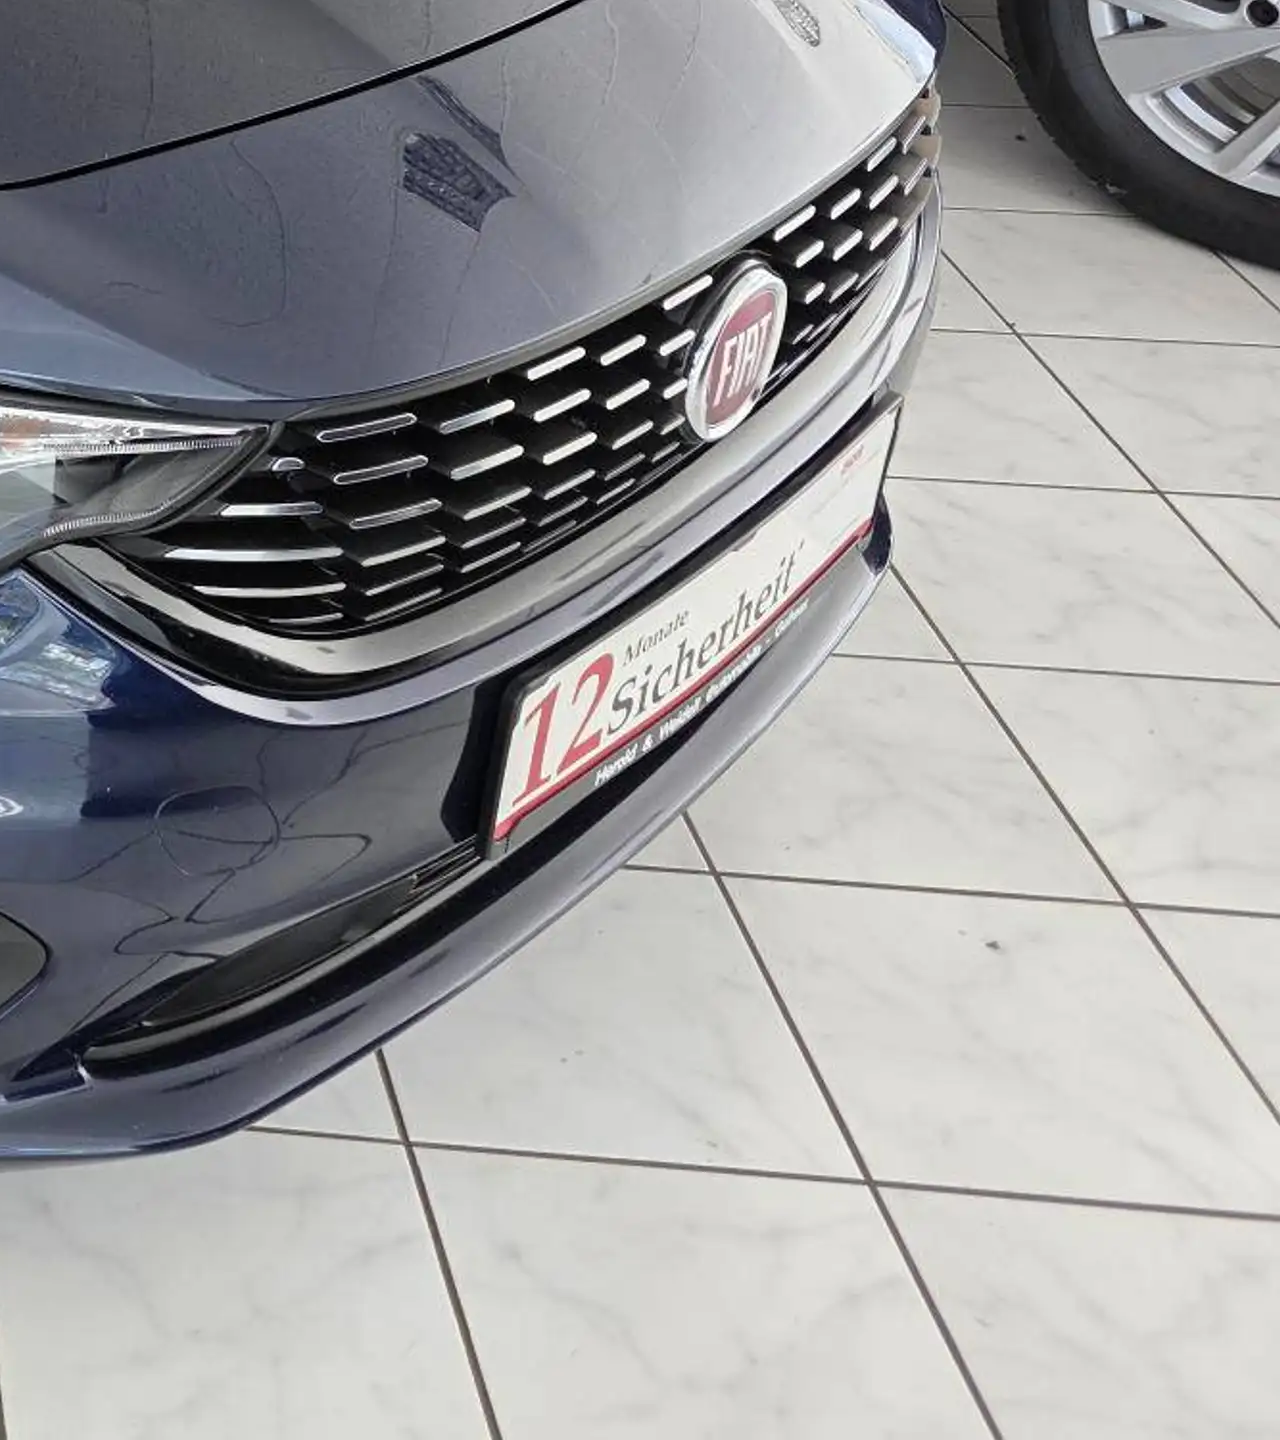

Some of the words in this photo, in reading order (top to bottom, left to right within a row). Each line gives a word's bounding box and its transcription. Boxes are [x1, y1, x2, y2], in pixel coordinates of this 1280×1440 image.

[712, 312, 773, 408] FIAT
[623, 611, 690, 666] Monate
[512, 653, 615, 807] 12
